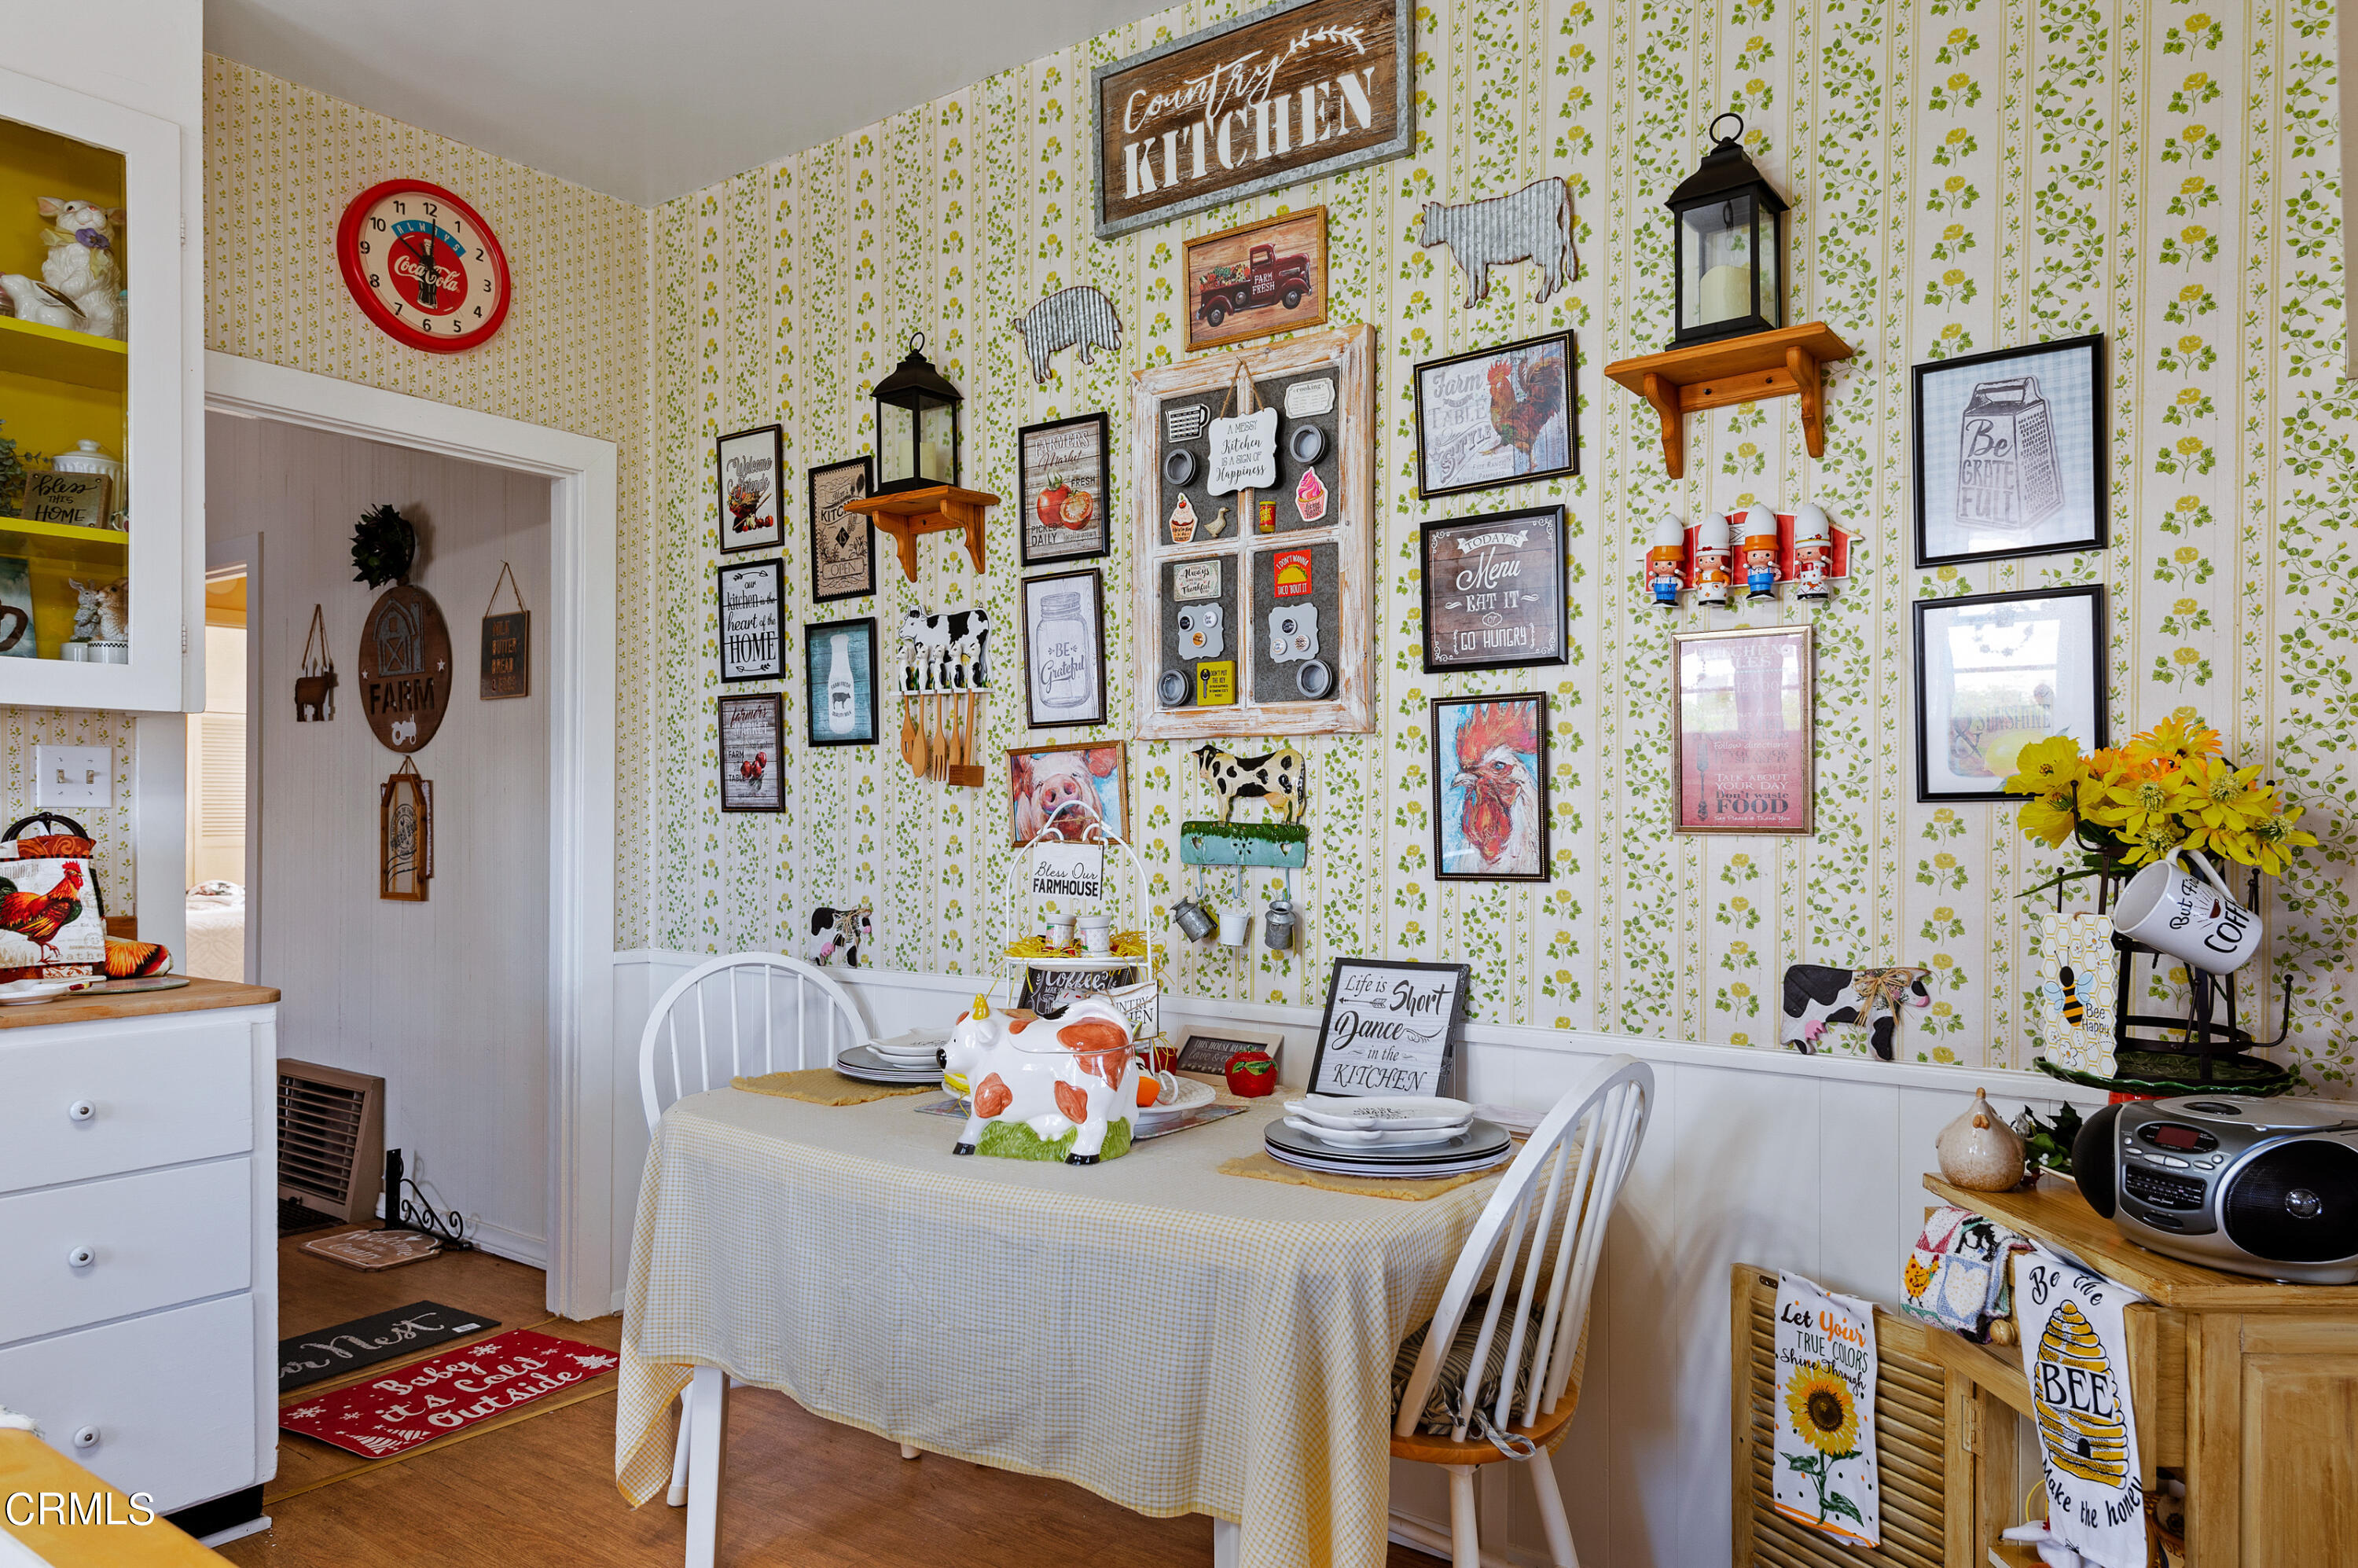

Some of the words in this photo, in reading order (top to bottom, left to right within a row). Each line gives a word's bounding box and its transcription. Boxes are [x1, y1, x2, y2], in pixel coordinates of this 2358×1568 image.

[1124, 50, 1283, 134] Country
[1124, 67, 1376, 200] KITCHEN
[423, 202, 438, 218] 12
[370, 216, 387, 232] 10
[359, 241, 371, 254] 9
[475, 248, 484, 262] 2
[369, 274, 380, 288] 8
[483, 279, 492, 292] 3
[1252, 281, 1275, 295] FRESH
[1254, 272, 1273, 285] FARM
[394, 302, 403, 316] 7
[473, 305, 483, 318] 4
[422, 318, 432, 332] 6
[453, 320, 462, 333] 5
[1433, 371, 1482, 398] Farm
[1428, 398, 1488, 429] TABLE
[1227, 424, 1233, 435] A
[1235, 420, 1258, 432] MESSY
[1034, 431, 1090, 457] FARMERS
[1221, 435, 1262, 454] Kitchen
[1966, 419, 2014, 457] Be
[1038, 450, 1082, 472] Market
[1221, 457, 1228, 466] IS
[1229, 455, 1235, 465] A
[1236, 453, 1252, 464] SIGN
[1253, 451, 1262, 462] OF
[1440, 424, 1492, 484] STYLE
[727, 454, 773, 477] Welcome
[1961, 459, 2014, 490] GRATE
[1071, 476, 1096, 487] FRESH
[1215, 465, 1266, 486] Happiness
[32, 475, 98, 496] bless
[727, 473, 770, 501] Friends
[48, 495, 74, 504] THIS
[1959, 487, 2018, 523] FULL
[35, 504, 86, 523] HOME
[839, 531, 847, 544] IS
[1031, 523, 1058, 534] PICKED
[1031, 532, 1057, 546] DAILY
[1465, 533, 1519, 551] TODAY'S
[830, 561, 856, 575] OPEN
[1292, 554, 1309, 567] WANNA
[1456, 545, 1522, 591] Menu
[744, 580, 756, 589] our
[1277, 585, 1289, 595] TACO
[1302, 582, 1307, 593] IT
[727, 589, 758, 611] kitchen
[759, 596, 766, 605] is
[766, 591, 776, 604] the
[1465, 593, 1497, 612] EAT
[1503, 590, 1520, 609] IT
[727, 611, 758, 631] heart
[758, 615, 766, 631] of
[767, 612, 776, 626] the
[491, 637, 517, 655] BUTTER
[729, 630, 777, 664] HOME
[1460, 631, 1476, 651] GO
[1483, 626, 1526, 648] HUNGRY
[1056, 642, 1070, 657] BE
[491, 657, 514, 674] BREAD
[1041, 655, 1085, 693] Grateful
[369, 678, 434, 715] FARM
[730, 705, 768, 728] farmers
[734, 721, 769, 736] MARKET
[1950, 711, 1982, 759] &
[1976, 704, 2051, 731] SUNSHINE
[728, 750, 744, 759] FARM
[729, 773, 746, 782] TABLE
[1715, 781, 1754, 791] YOUR
[1761, 781, 1790, 791] DAY
[1716, 790, 1749, 799] Don't
[1716, 798, 1789, 814] FOOD
[1034, 861, 1068, 879] Bless
[1071, 862, 1098, 880] Our
[1033, 878, 1099, 898] FARMHOUSE
[2169, 898, 2193, 930] But
[1344, 973, 1372, 997] Life
[1376, 975, 1387, 993] is
[1390, 979, 1453, 1017] Short
[2085, 1003, 2106, 1020] Bee
[1331, 1010, 1404, 1051] Dance
[2081, 1019, 2110, 1037] Happy
[1194, 1040, 1208, 1049] THIS
[1210, 1041, 1230, 1052] HOUSE
[1367, 1045, 1379, 1059] in
[1381, 1045, 1400, 1061] the
[1332, 1063, 1427, 1092] KITCHEN
[346, 1233, 413, 1257] Welcome
[2029, 1265, 2061, 1305] Be
[2073, 1272, 2103, 1307] the
[1780, 1302, 1813, 1328] Let
[1819, 1309, 1867, 1348] Your
[300, 1312, 445, 1359] Nest
[1796, 1330, 1826, 1357] TRUE
[1832, 1341, 1868, 1374] COLORS
[373, 1359, 489, 1396] Baby
[1780, 1346, 1819, 1371] Shine
[1820, 1359, 1867, 1397] Through
[374, 1394, 456, 1423] it's
[454, 1356, 548, 1393] Cold
[427, 1371, 583, 1427] Outside
[2042, 1362, 2114, 1419] BEE
[2080, 1499, 2098, 1529] the
